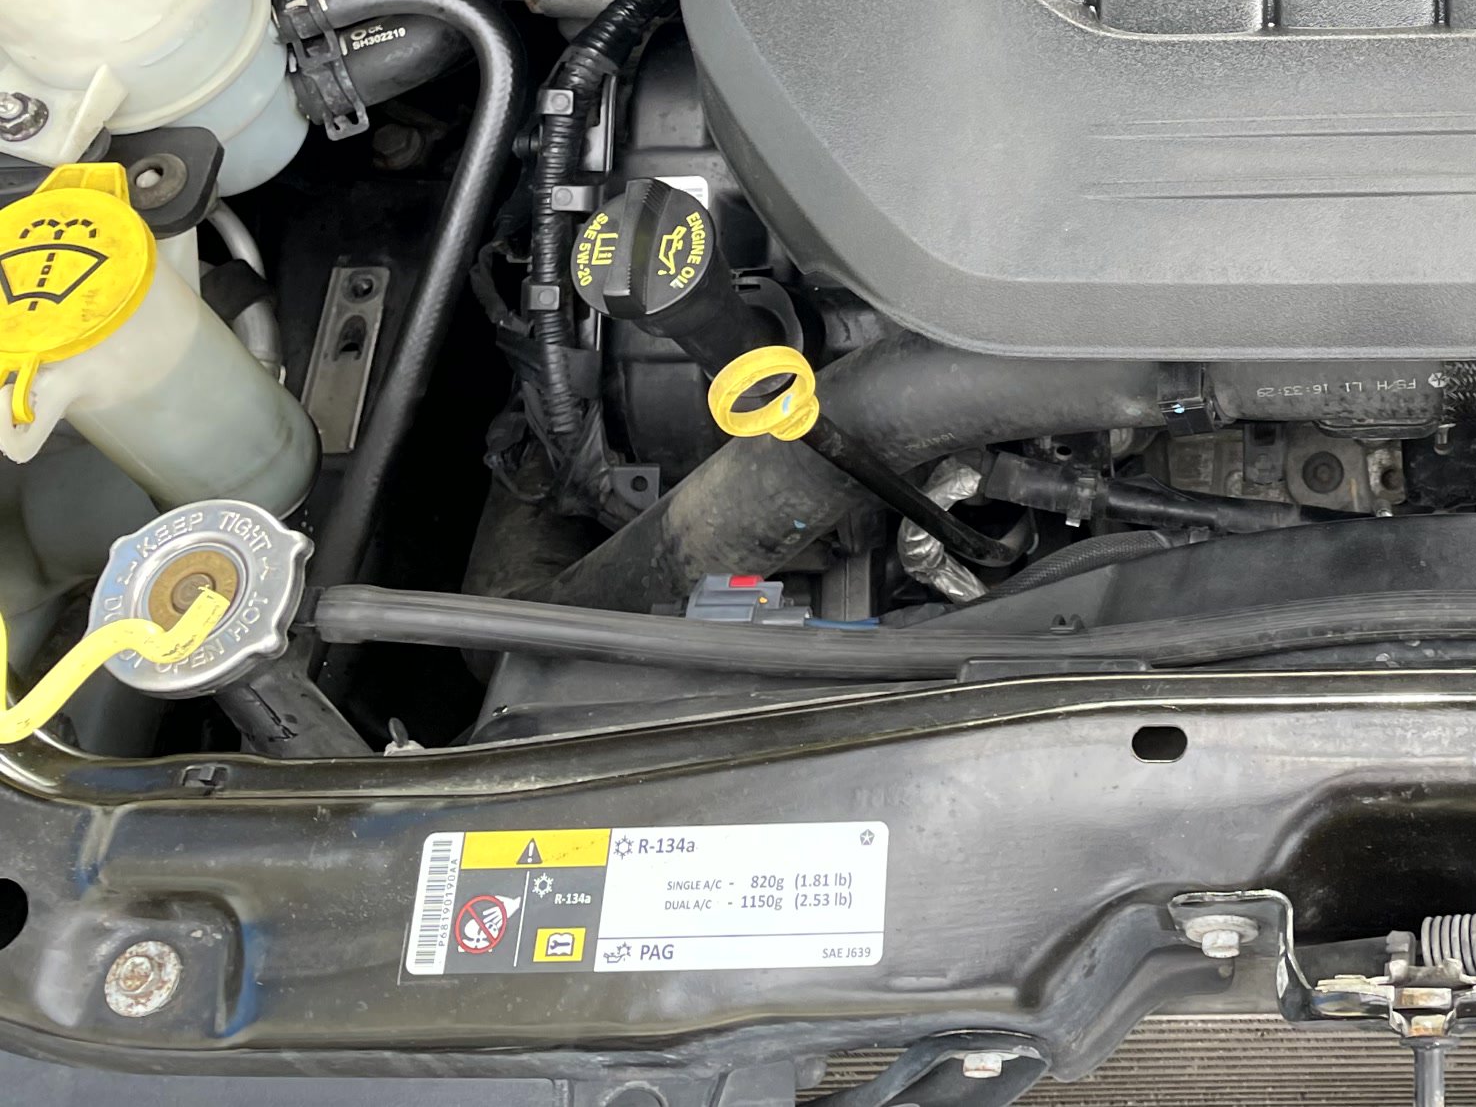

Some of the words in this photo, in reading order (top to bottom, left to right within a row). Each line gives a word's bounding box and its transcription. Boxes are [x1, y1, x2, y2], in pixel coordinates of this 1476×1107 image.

[584, 212, 609, 241] SAE
[686, 211, 706, 265] ENGINE
[576, 243, 593, 287] 5W-20
[670, 267, 696, 289] OIL
[136, 512, 204, 558] KEEP
[217, 511, 273, 553] TIGHT
[232, 592, 269, 642] HOT
[638, 837, 696, 855] R-134a
[666, 879, 700, 891] SINGLE
[700, 879, 722, 891] A/C
[750, 873, 784, 892] 820g
[794, 873, 828, 890] (1.81
[833, 873, 854, 890] lb)
[438, 857, 458, 947] P68190190AA
[554, 893, 592, 905] R-134a
[664, 899, 687, 911] DUAL
[689, 898, 712, 912] A/C
[740, 893, 784, 911] 1150g
[794, 892, 829, 909] (2.53
[833, 892, 854, 909] lb)
[640, 944, 674, 962] PAG
[822, 947, 844, 959] SAE
[844, 945, 872, 959] J639
